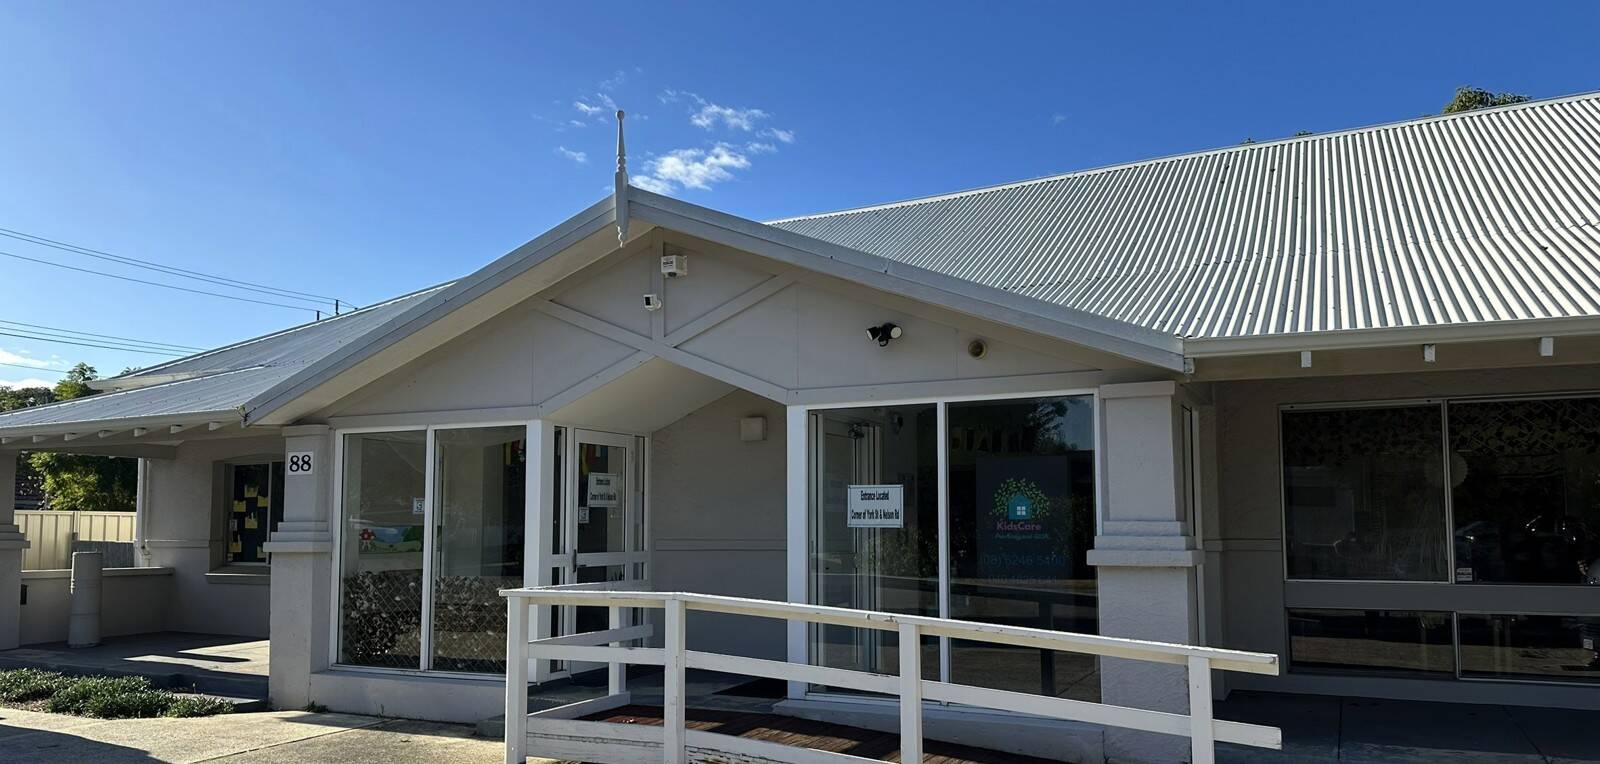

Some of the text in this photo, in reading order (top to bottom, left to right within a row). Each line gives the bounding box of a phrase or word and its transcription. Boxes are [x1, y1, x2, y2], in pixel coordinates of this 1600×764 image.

[290, 455, 311, 472] 88
[861, 490, 875, 500] Entrance
[996, 521, 1041, 531] KidsCare
